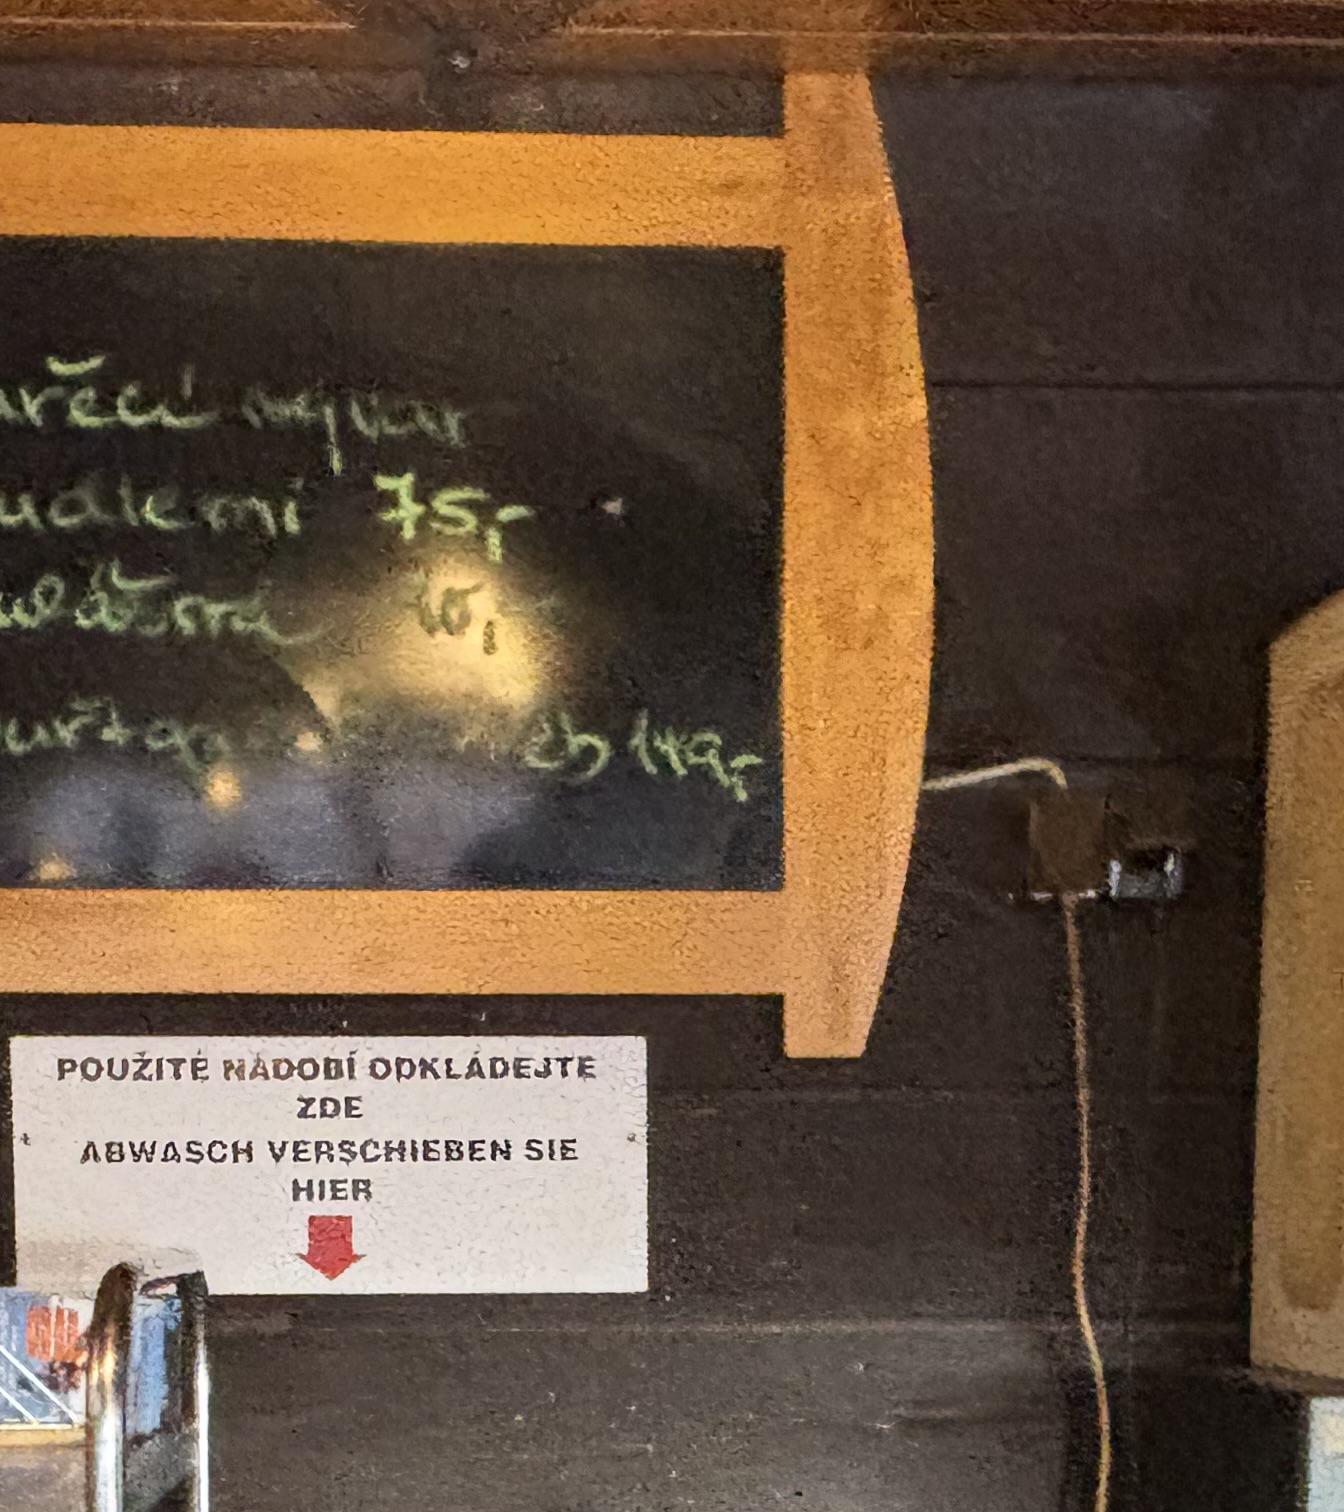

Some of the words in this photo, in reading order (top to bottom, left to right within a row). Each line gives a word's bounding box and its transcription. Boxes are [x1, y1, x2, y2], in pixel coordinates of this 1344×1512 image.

[57, 1049, 209, 1082] POUŽITÉ
[223, 1050, 357, 1082] NÁDOBÍ
[368, 1050, 596, 1082] ODKLÁDEJTE
[296, 1095, 363, 1119] ZDE
[80, 1140, 254, 1164] ABWASCH
[267, 1138, 512, 1165] VERSCHIEBEN
[524, 1138, 579, 1161] SIE
[292, 1178, 373, 1202] HIER
